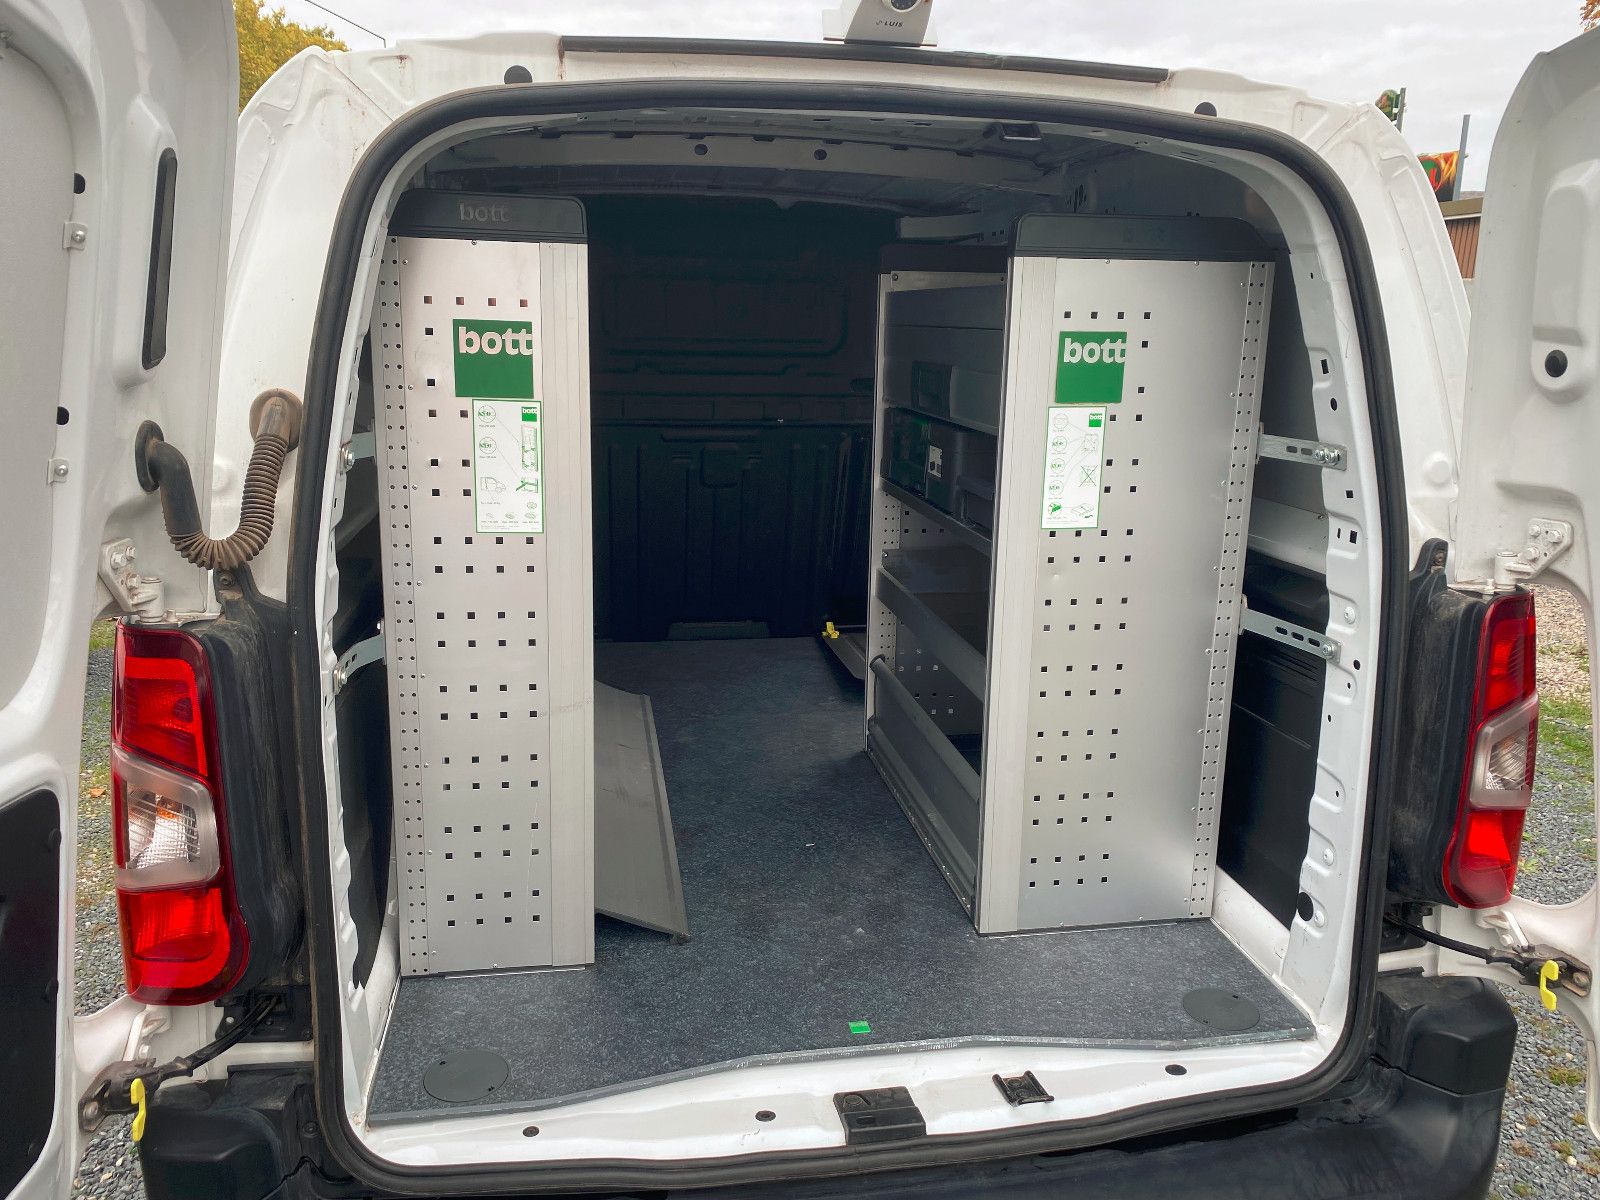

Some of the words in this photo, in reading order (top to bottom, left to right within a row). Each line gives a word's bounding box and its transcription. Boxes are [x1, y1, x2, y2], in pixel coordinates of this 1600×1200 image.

[459, 203, 510, 222] bott
[458, 326, 533, 356] bott
[1063, 337, 1127, 364] bott
